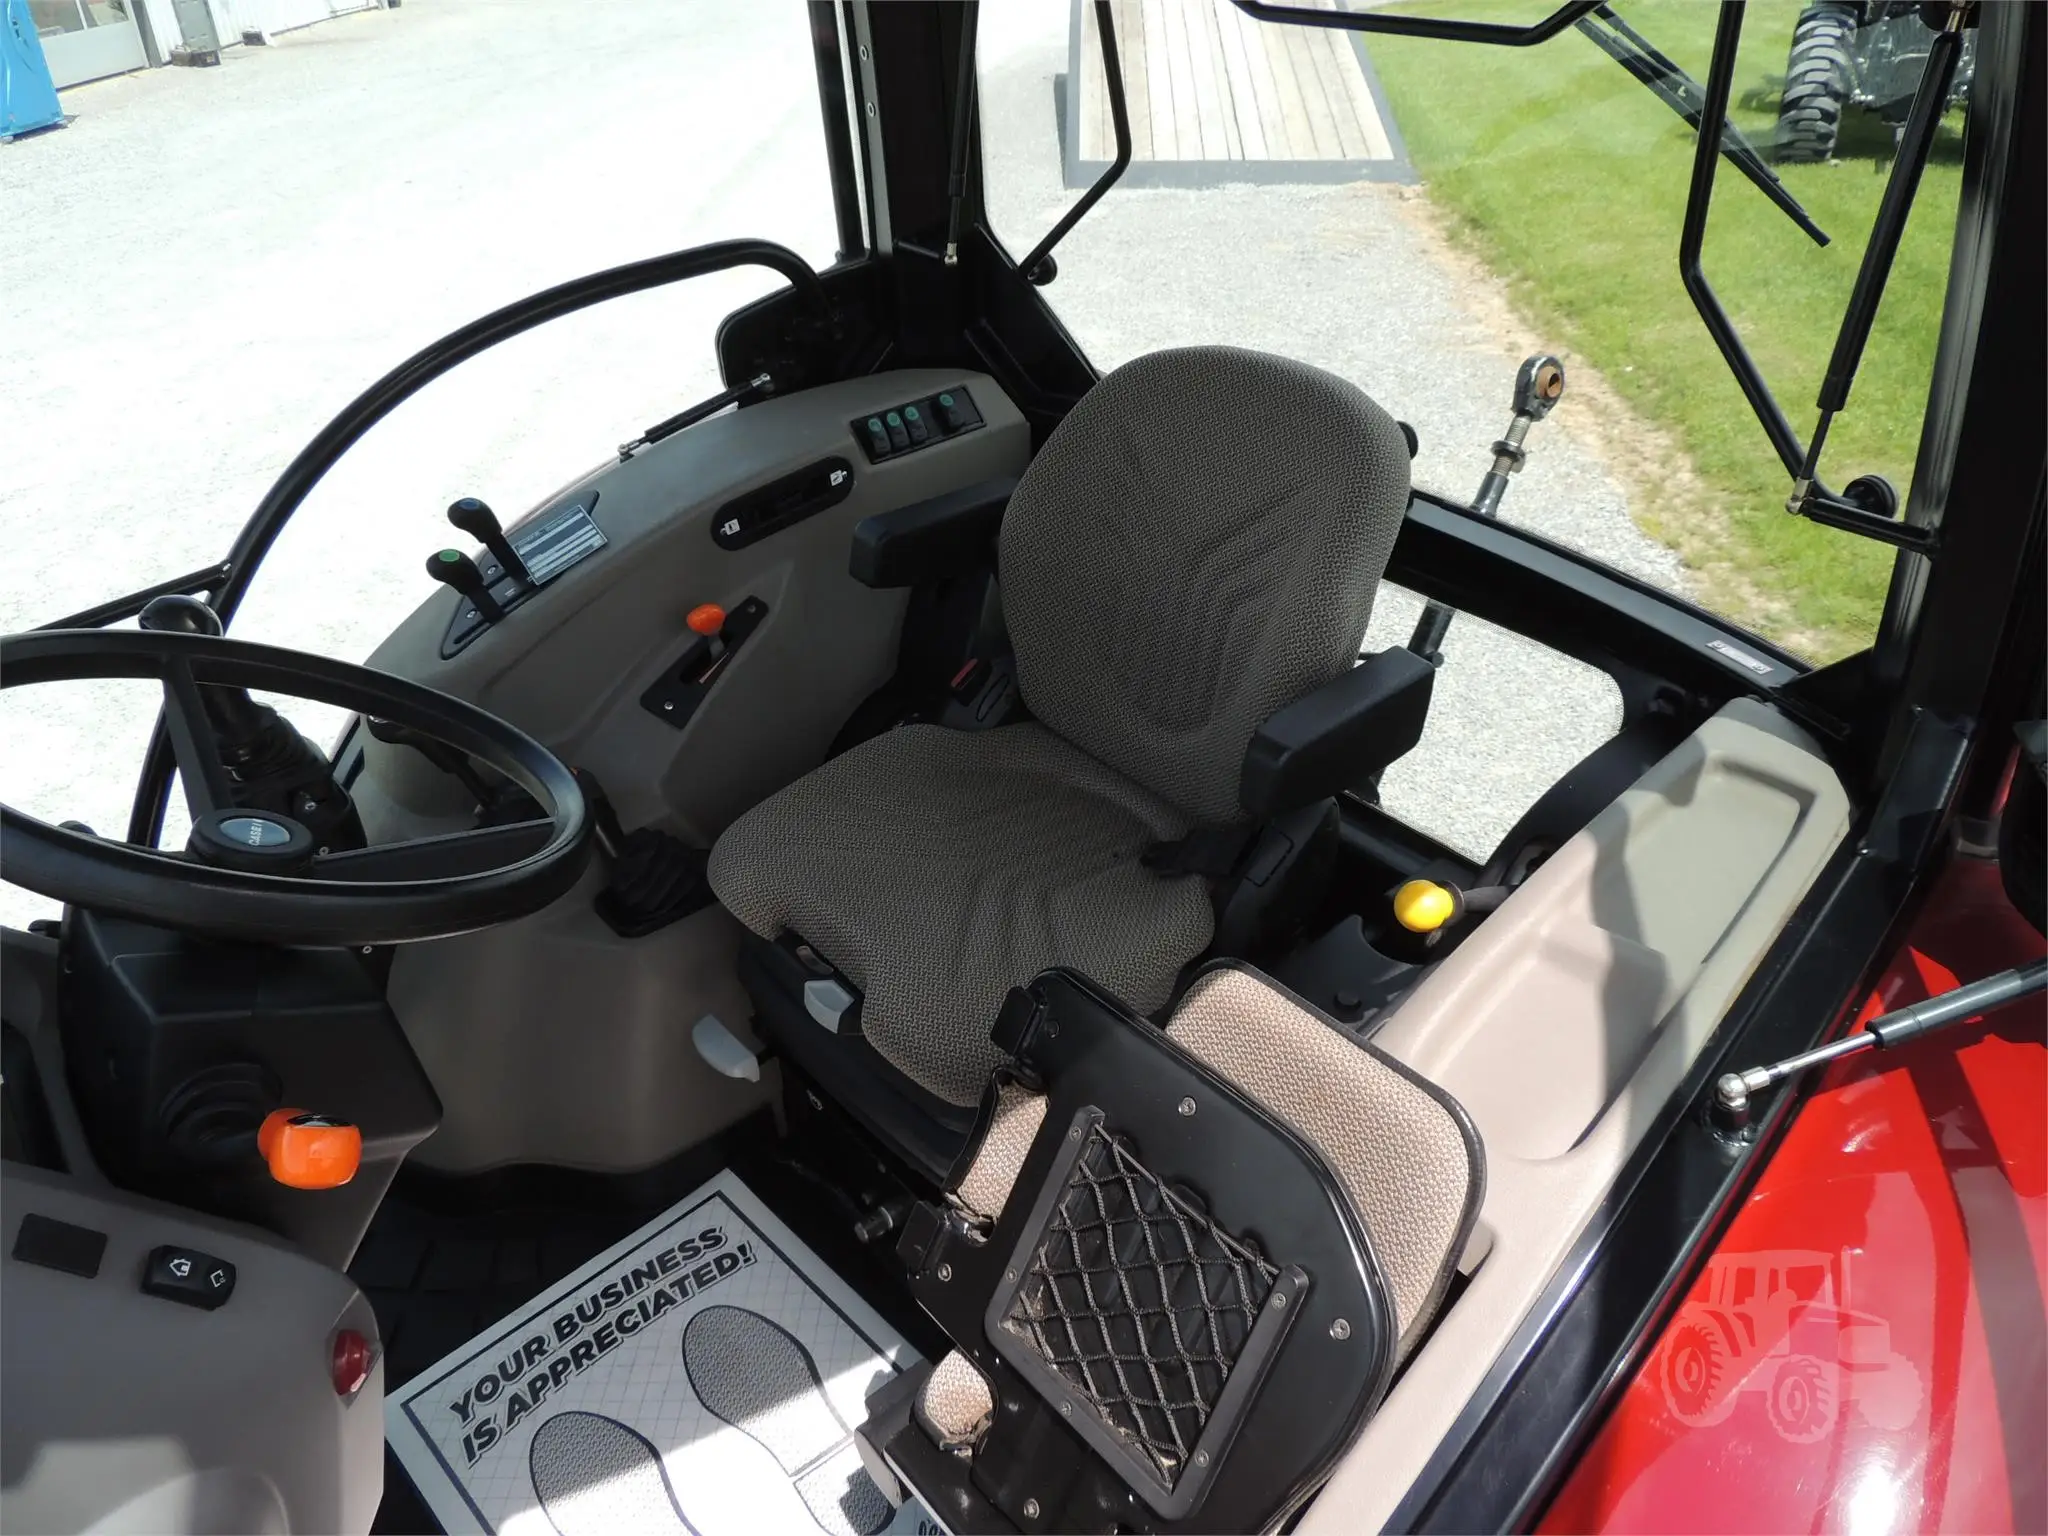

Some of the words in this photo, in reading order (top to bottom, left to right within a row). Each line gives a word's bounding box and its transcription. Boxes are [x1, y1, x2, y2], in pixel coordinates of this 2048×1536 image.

[449, 1335, 551, 1424] YOUR
[552, 1227, 726, 1344] BUSINESS
[462, 1416, 501, 1465] IS
[506, 1243, 754, 1429] APPRECIATED!
